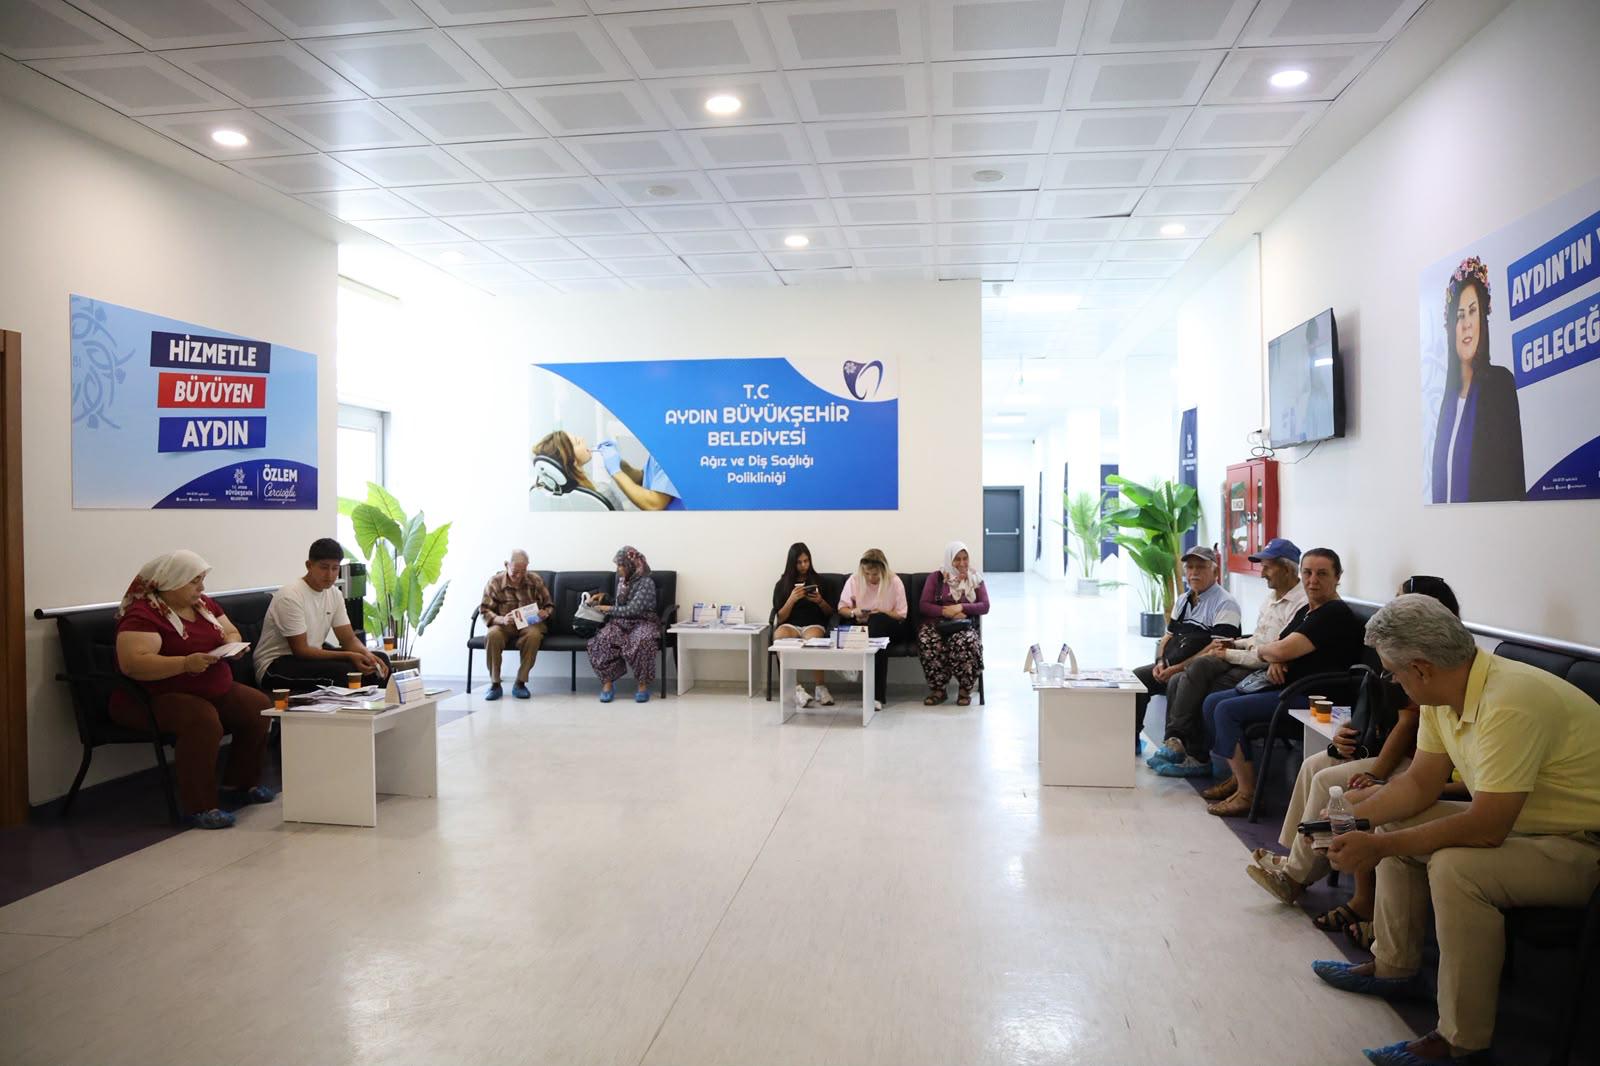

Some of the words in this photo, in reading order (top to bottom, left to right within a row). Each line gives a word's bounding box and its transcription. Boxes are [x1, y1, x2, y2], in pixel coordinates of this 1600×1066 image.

[1512, 233, 1592, 307] AYDIN'IN
[169, 334, 257, 367] HİZMETLE
[1521, 303, 1600, 373] GELECEĞ
[174, 375, 254, 404] BÜYÜYEN
[743, 384, 770, 400] T.C
[665, 409, 718, 425] AYDIN
[723, 402, 850, 428] BÜYÜKŞEHİR
[182, 420, 249, 448] AYDIN
[708, 426, 806, 446] BELEDİYESİ
[262, 464, 298, 482] ÖZLEM
[700, 455, 726, 469] Ağız
[731, 457, 745, 467] ve
[748, 455, 768, 469] Diş
[771, 454, 814, 469] Sağlığı
[727, 471, 787, 486] Polikliniği
